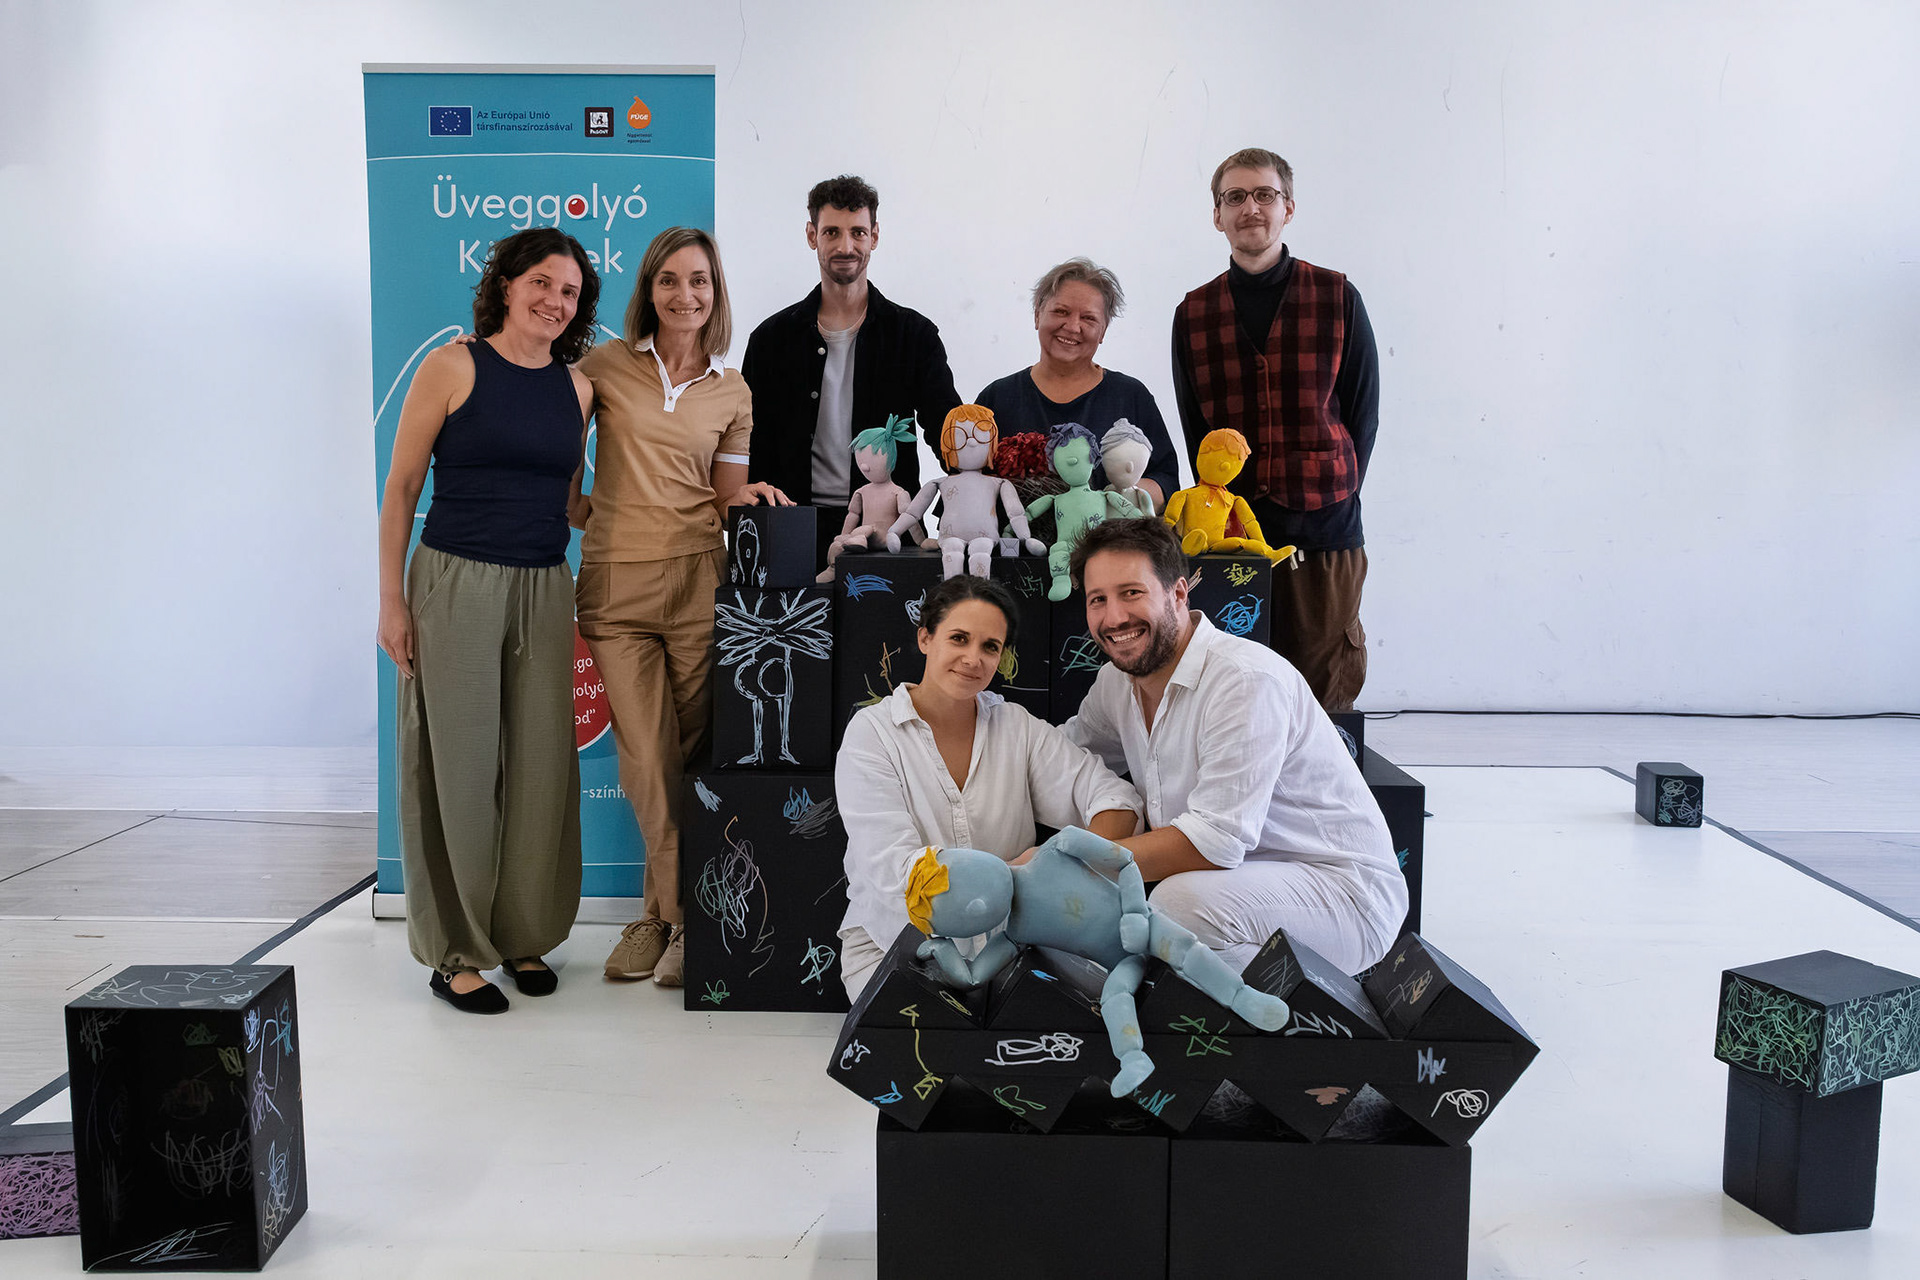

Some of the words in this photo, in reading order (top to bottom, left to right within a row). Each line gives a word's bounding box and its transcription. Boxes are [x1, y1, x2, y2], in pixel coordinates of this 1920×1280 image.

[476, 111, 489, 119] Az
[491, 110, 527, 121] Európai
[529, 110, 551, 120] Unió
[476, 122, 573, 132] társfinanszírozásával
[433, 174, 648, 232] Üveggolyó
[574, 657, 594, 674] go
[573, 678, 605, 700] olyó
